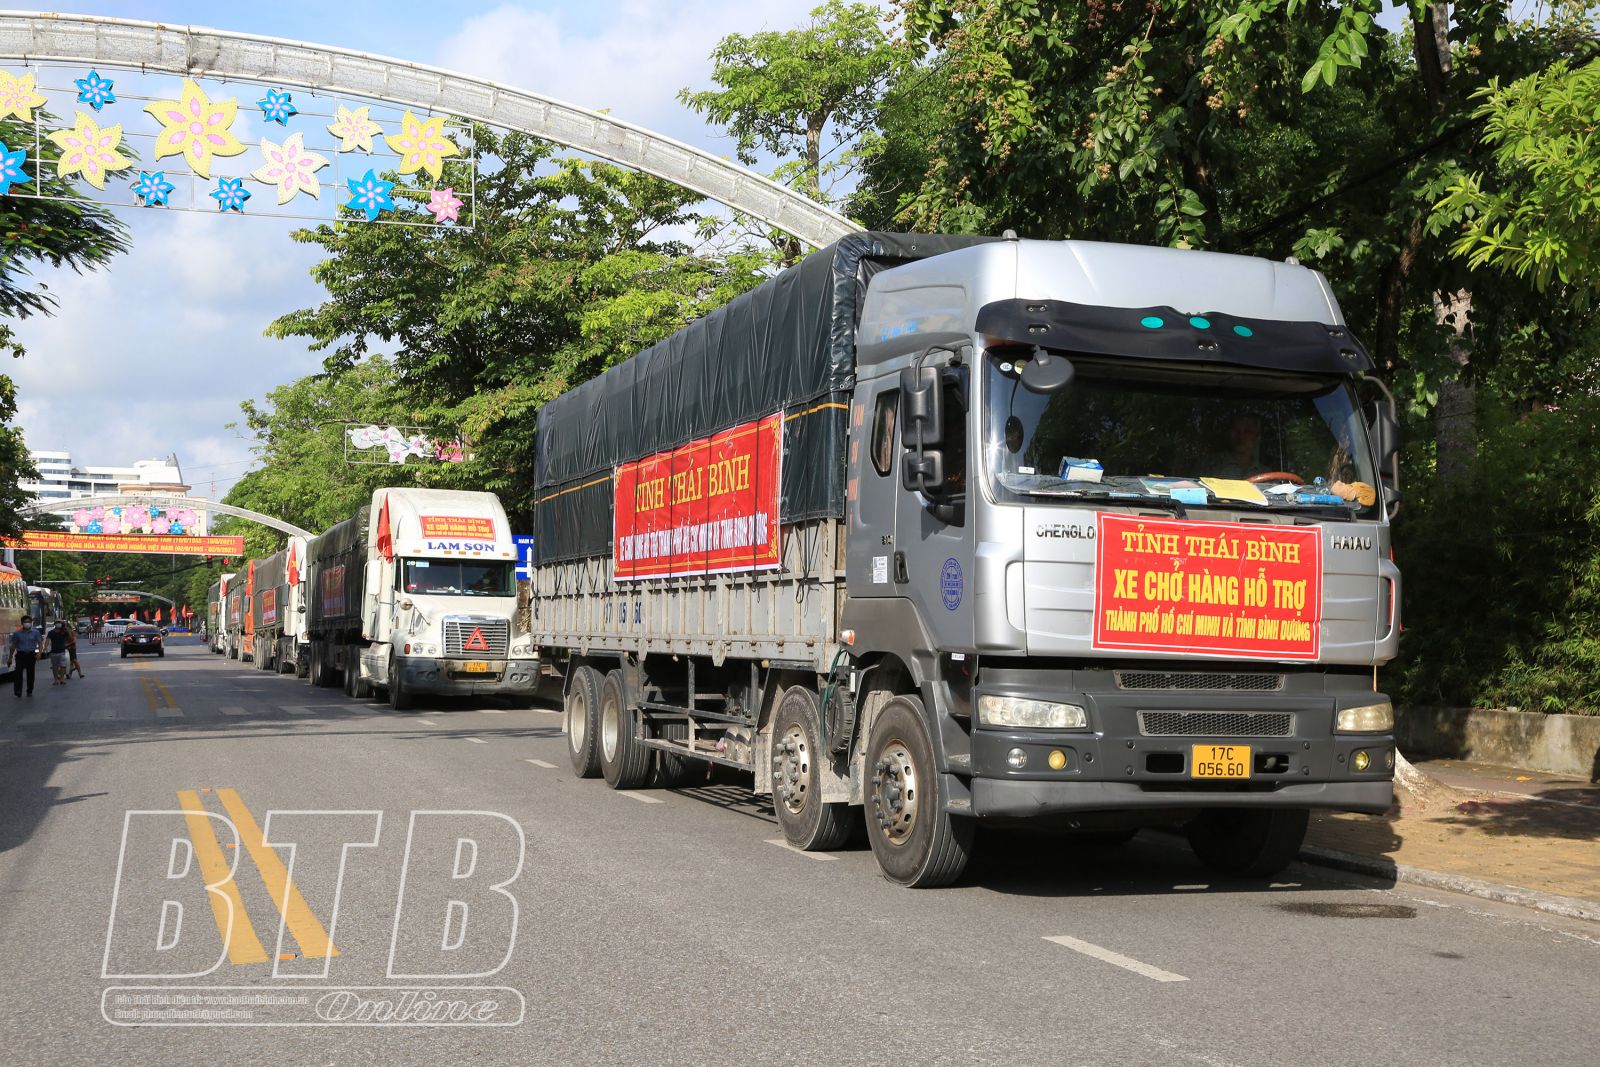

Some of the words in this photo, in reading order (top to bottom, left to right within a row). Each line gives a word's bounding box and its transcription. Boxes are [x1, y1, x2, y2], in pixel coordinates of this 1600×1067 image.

[668, 458, 703, 506] THÁI
[708, 450, 750, 497] BÌNH
[1036, 524, 1096, 540] CHENGLO
[1121, 523, 1180, 555] TỈNH
[1185, 532, 1240, 560] THÁI
[1246, 535, 1300, 564] BÌNH
[428, 542, 460, 550] LAM
[1113, 568, 1138, 599] XE
[1144, 560, 1184, 602] CHỞ
[1188, 568, 1239, 606] HÀNG
[1244, 567, 1268, 608] HỖ
[1272, 579, 1307, 616] TRỢ
[1105, 606, 1138, 632] THÀNH
[1138, 604, 1160, 634] PHỐ
[1160, 606, 1175, 634] HỒ
[1176, 610, 1194, 635] CHÍ
[1194, 614, 1220, 636] MINH
[1222, 612, 1234, 638] VÀ
[1236, 610, 1256, 638] TỈNH
[1257, 614, 1280, 640] BÌNH
[1211, 747, 1234, 760] 17C
[1198, 762, 1244, 776] 056.60
